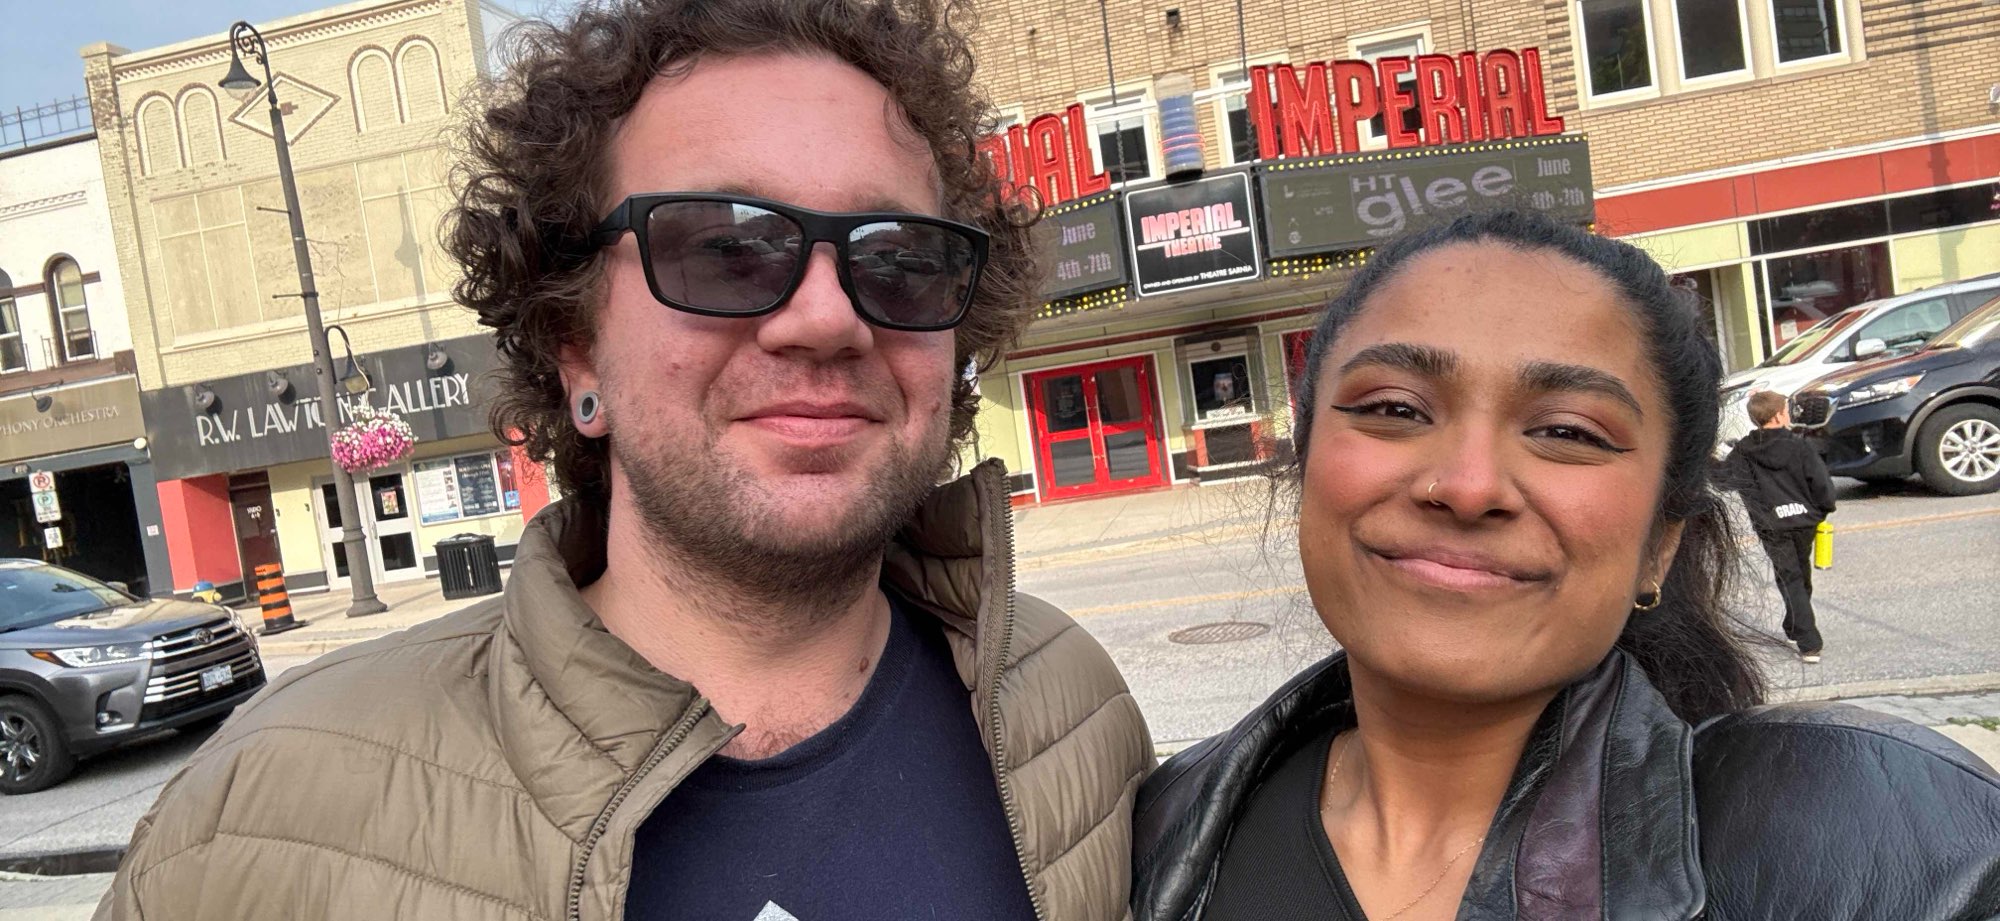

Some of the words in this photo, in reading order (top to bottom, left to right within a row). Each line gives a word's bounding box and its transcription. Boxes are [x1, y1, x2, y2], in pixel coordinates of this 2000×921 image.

[1248, 47, 1565, 160] IMPERIAL
[1537, 157, 1572, 177] June
[1357, 165, 1513, 237] glee
[1062, 222, 1096, 246] June
[1141, 202, 1242, 244] IMPERIAL
[1164, 234, 1222, 258] THEATRE
[1057, 259, 1081, 280] 4th
[1200, 268, 1228, 280] THEATRE
[1228, 265, 1253, 275] SARNIA
[360, 373, 470, 418] ALLERY
[43, 405, 120, 429] ORCHESTRA
